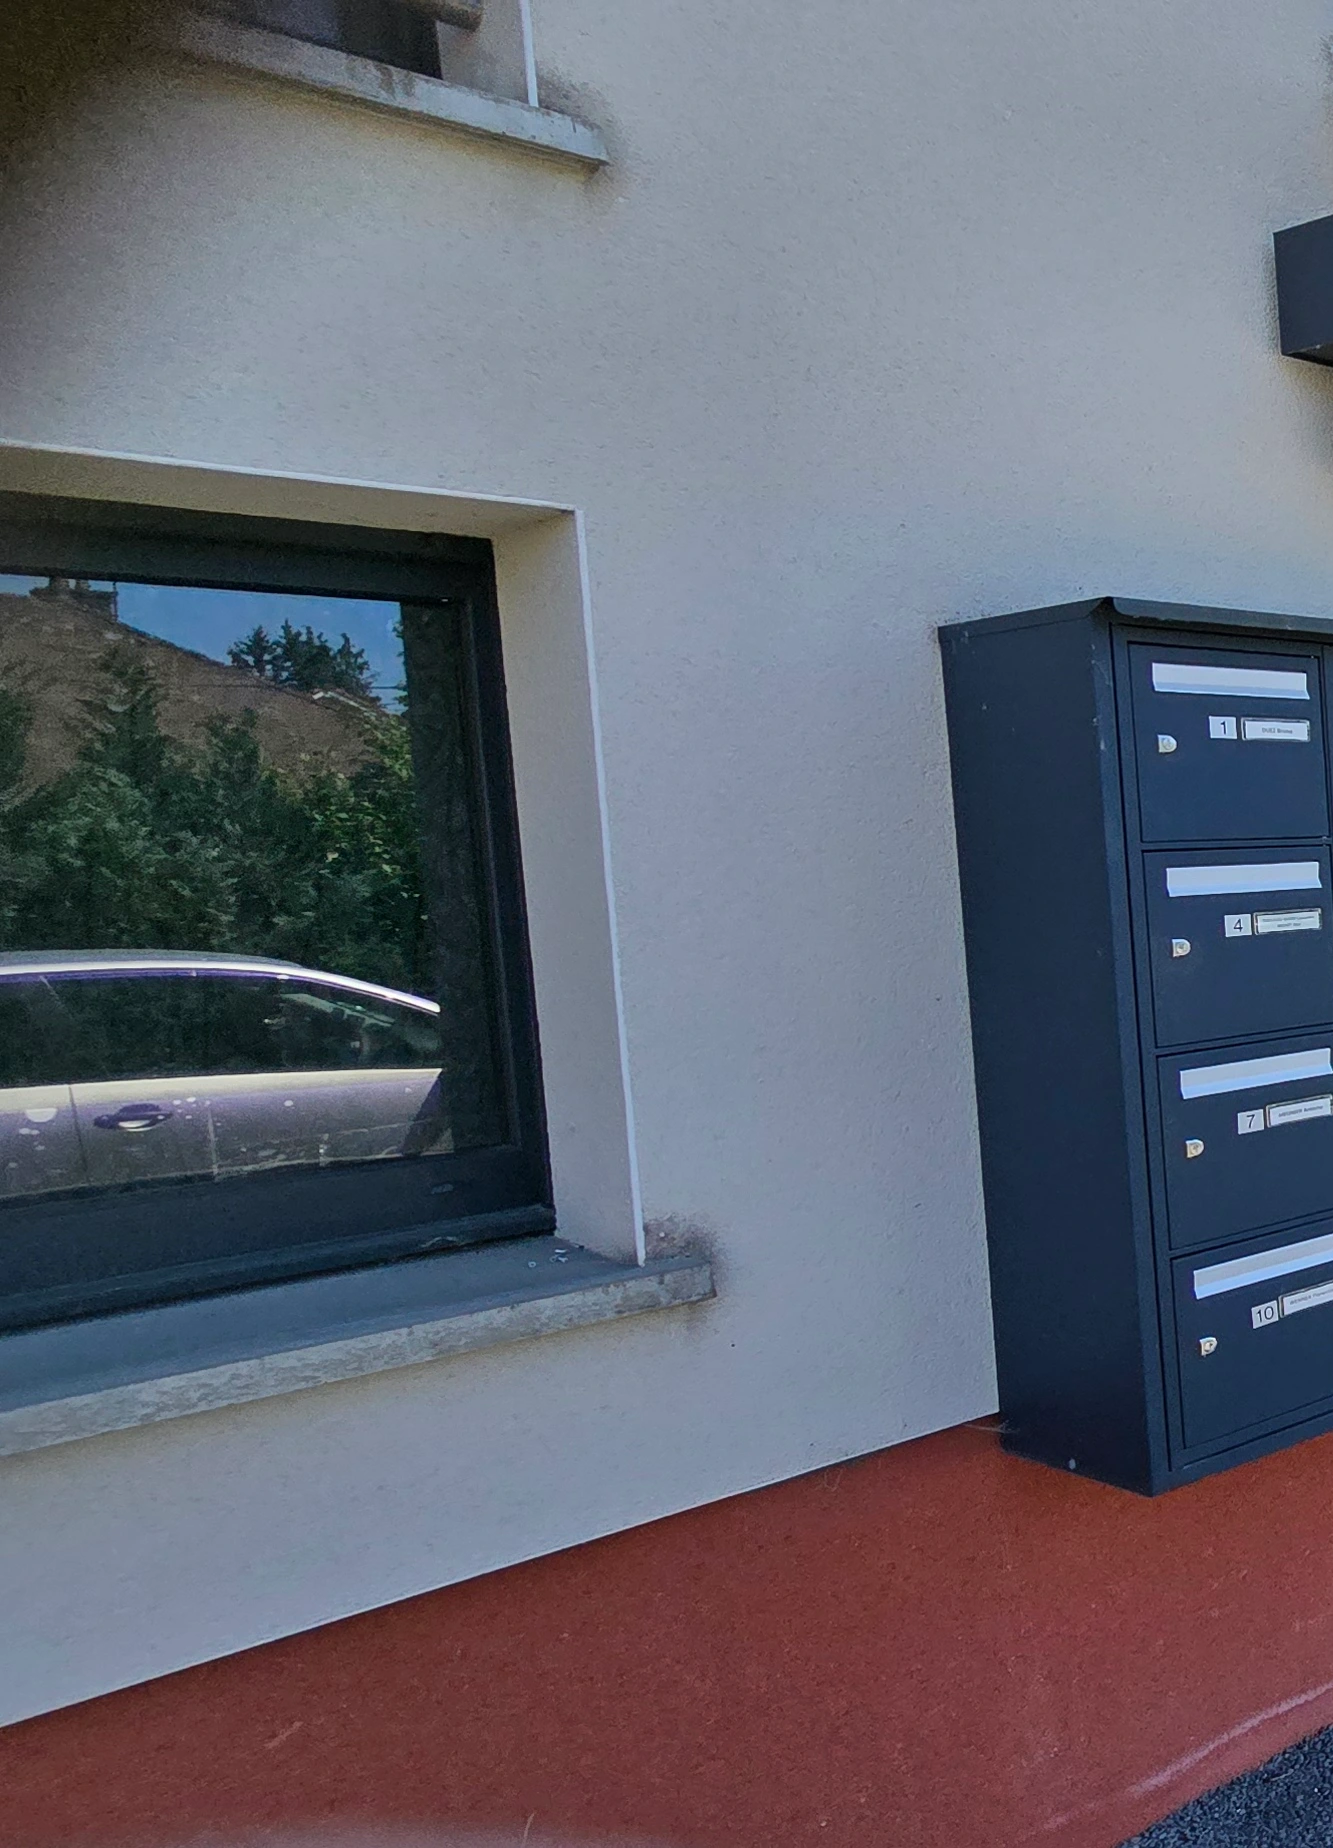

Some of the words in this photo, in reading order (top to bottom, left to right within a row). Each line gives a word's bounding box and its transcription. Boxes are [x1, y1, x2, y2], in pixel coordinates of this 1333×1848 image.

[1219, 720, 1228, 736] 1
[1233, 918, 1243, 933] 4
[1246, 1113, 1256, 1129] 7
[1255, 1305, 1275, 1323] 10
